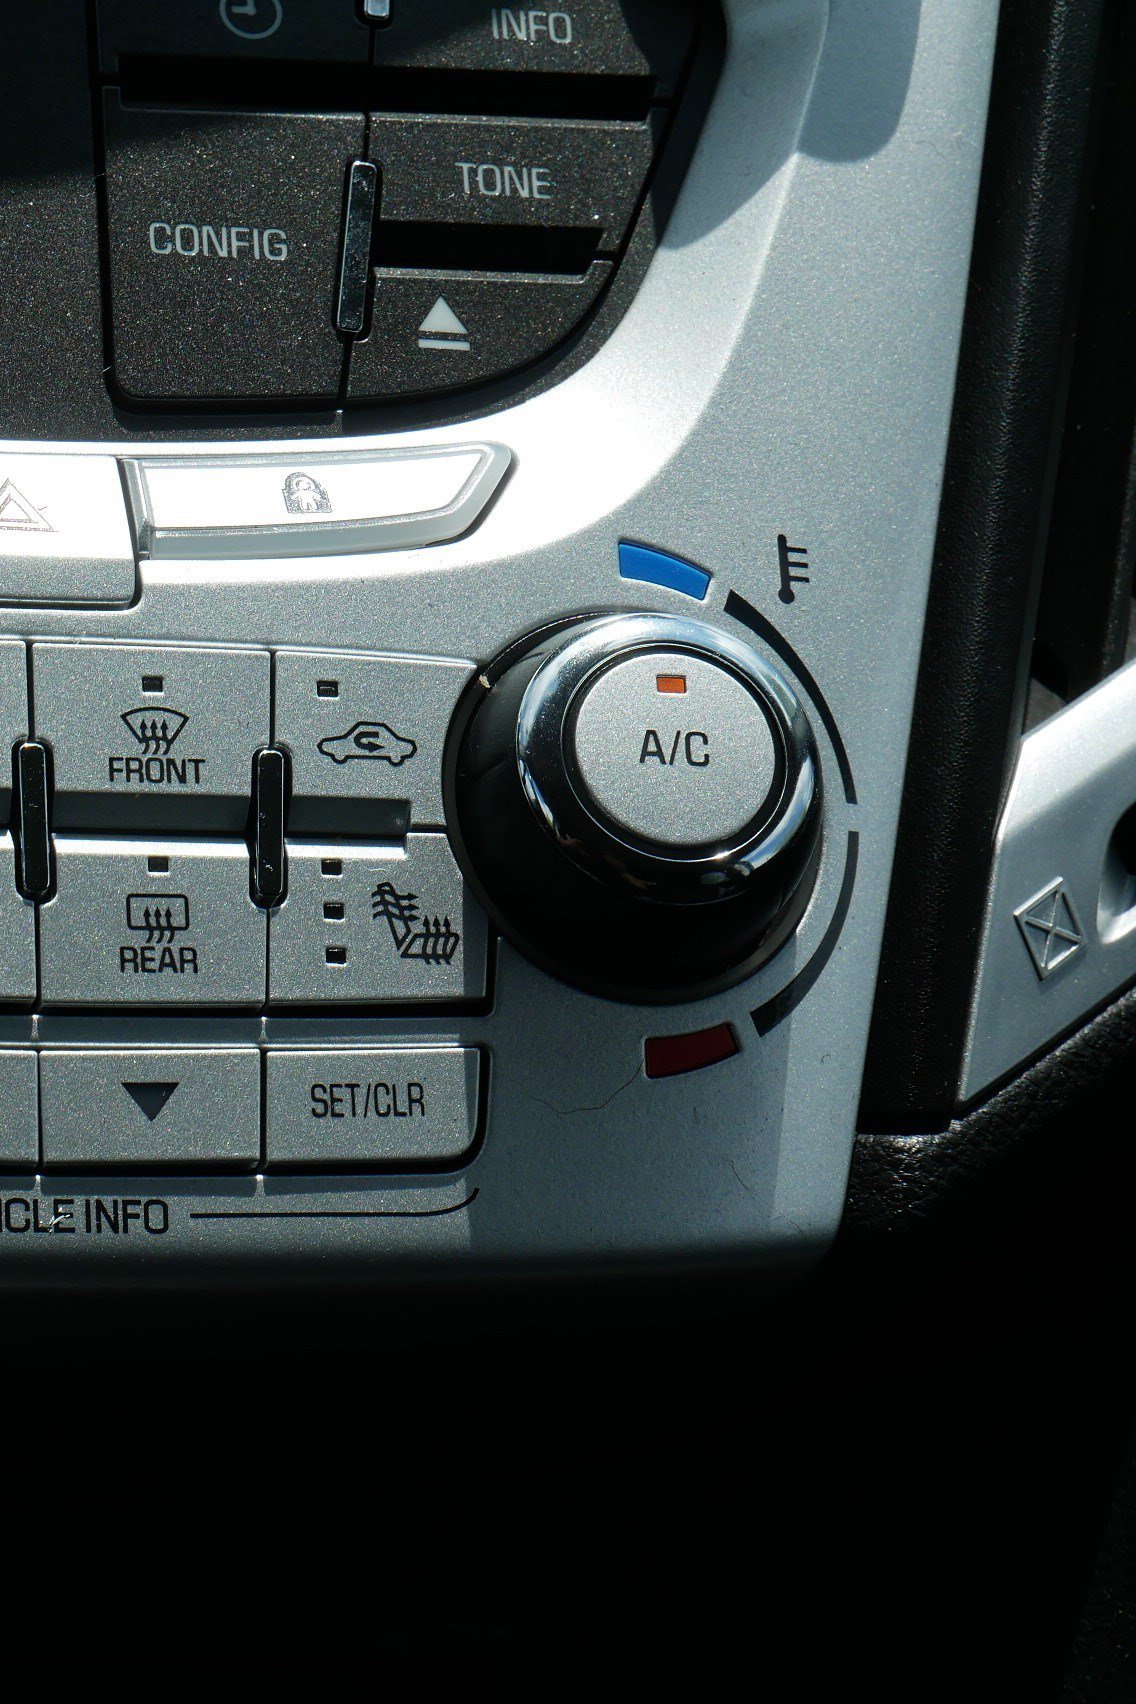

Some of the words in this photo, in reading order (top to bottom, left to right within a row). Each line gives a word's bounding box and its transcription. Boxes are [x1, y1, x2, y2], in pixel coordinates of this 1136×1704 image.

[491, 8, 573, 46] INFO
[454, 162, 553, 200] TONE
[146, 222, 289, 262] CONFIG
[639, 729, 710, 768] A/C
[108, 756, 206, 785] FRONT
[119, 945, 199, 975] REAR
[310, 1081, 426, 1119] SET/CLR
[83, 1197, 171, 1236] INFO
